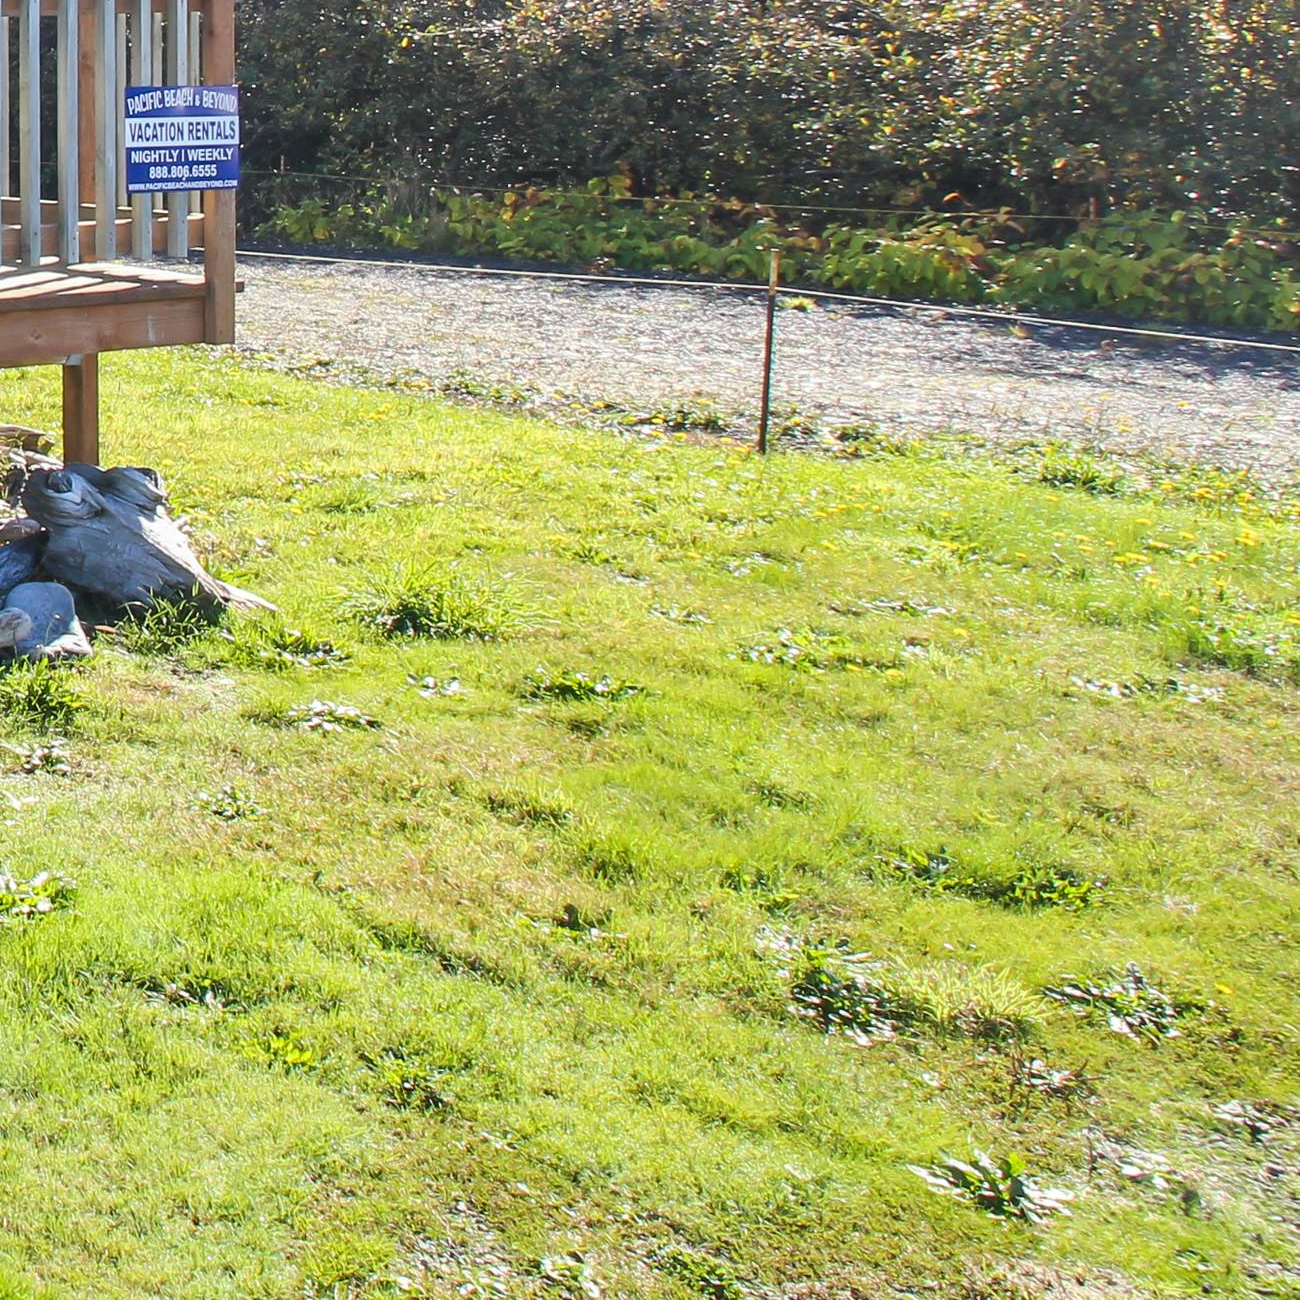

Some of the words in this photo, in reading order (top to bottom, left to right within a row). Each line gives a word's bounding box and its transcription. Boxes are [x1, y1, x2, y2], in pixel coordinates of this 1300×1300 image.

[127, 90, 163, 115] PACIFIC
[164, 88, 193, 107] BEACH
[195, 94, 200, 106] &
[202, 90, 238, 112] BEYOND
[129, 122, 183, 142] VACATION
[188, 121, 236, 140] RENTALS
[131, 149, 179, 163] NIGHTLY
[187, 148, 233, 161] WEEKLY
[149, 164, 217, 179] 888.806.6555
